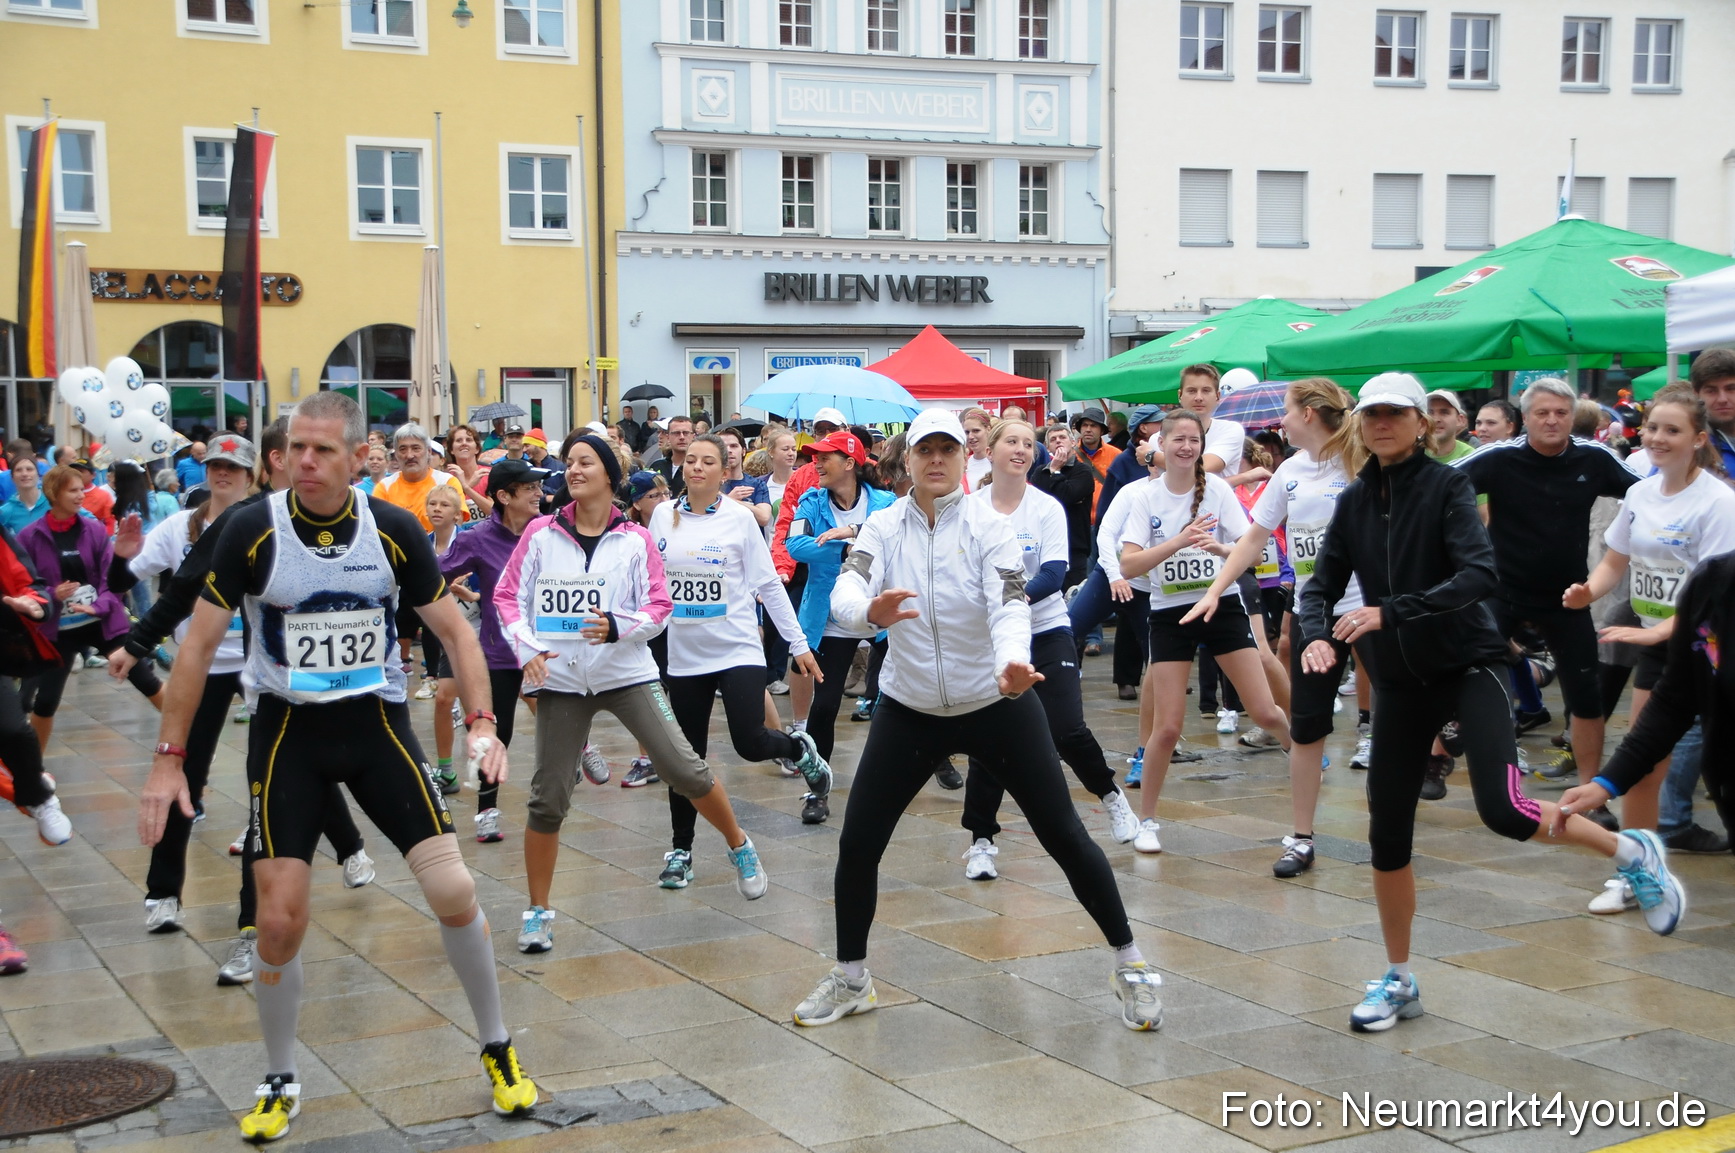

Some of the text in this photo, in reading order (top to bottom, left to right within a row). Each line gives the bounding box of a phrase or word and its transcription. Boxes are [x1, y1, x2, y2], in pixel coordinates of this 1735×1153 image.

[788, 86, 977, 119] BRILLEN WEBER
[764, 272, 994, 303] BRILLEN WEBER
[776, 357, 817, 368] BRILLEN
[343, 564, 379, 572] DIADORA
[1164, 558, 1215, 581] 5038
[671, 579, 722, 602] 2839
[1635, 571, 1680, 602] 5037
[541, 589, 601, 613] 3029
[685, 608, 705, 616] Nina
[288, 619, 370, 631] PARTL Neumarkt
[562, 620, 579, 630] Eva
[298, 631, 377, 668] 2132
[330, 675, 350, 689] ralf
[252, 796, 263, 853] SKINS
